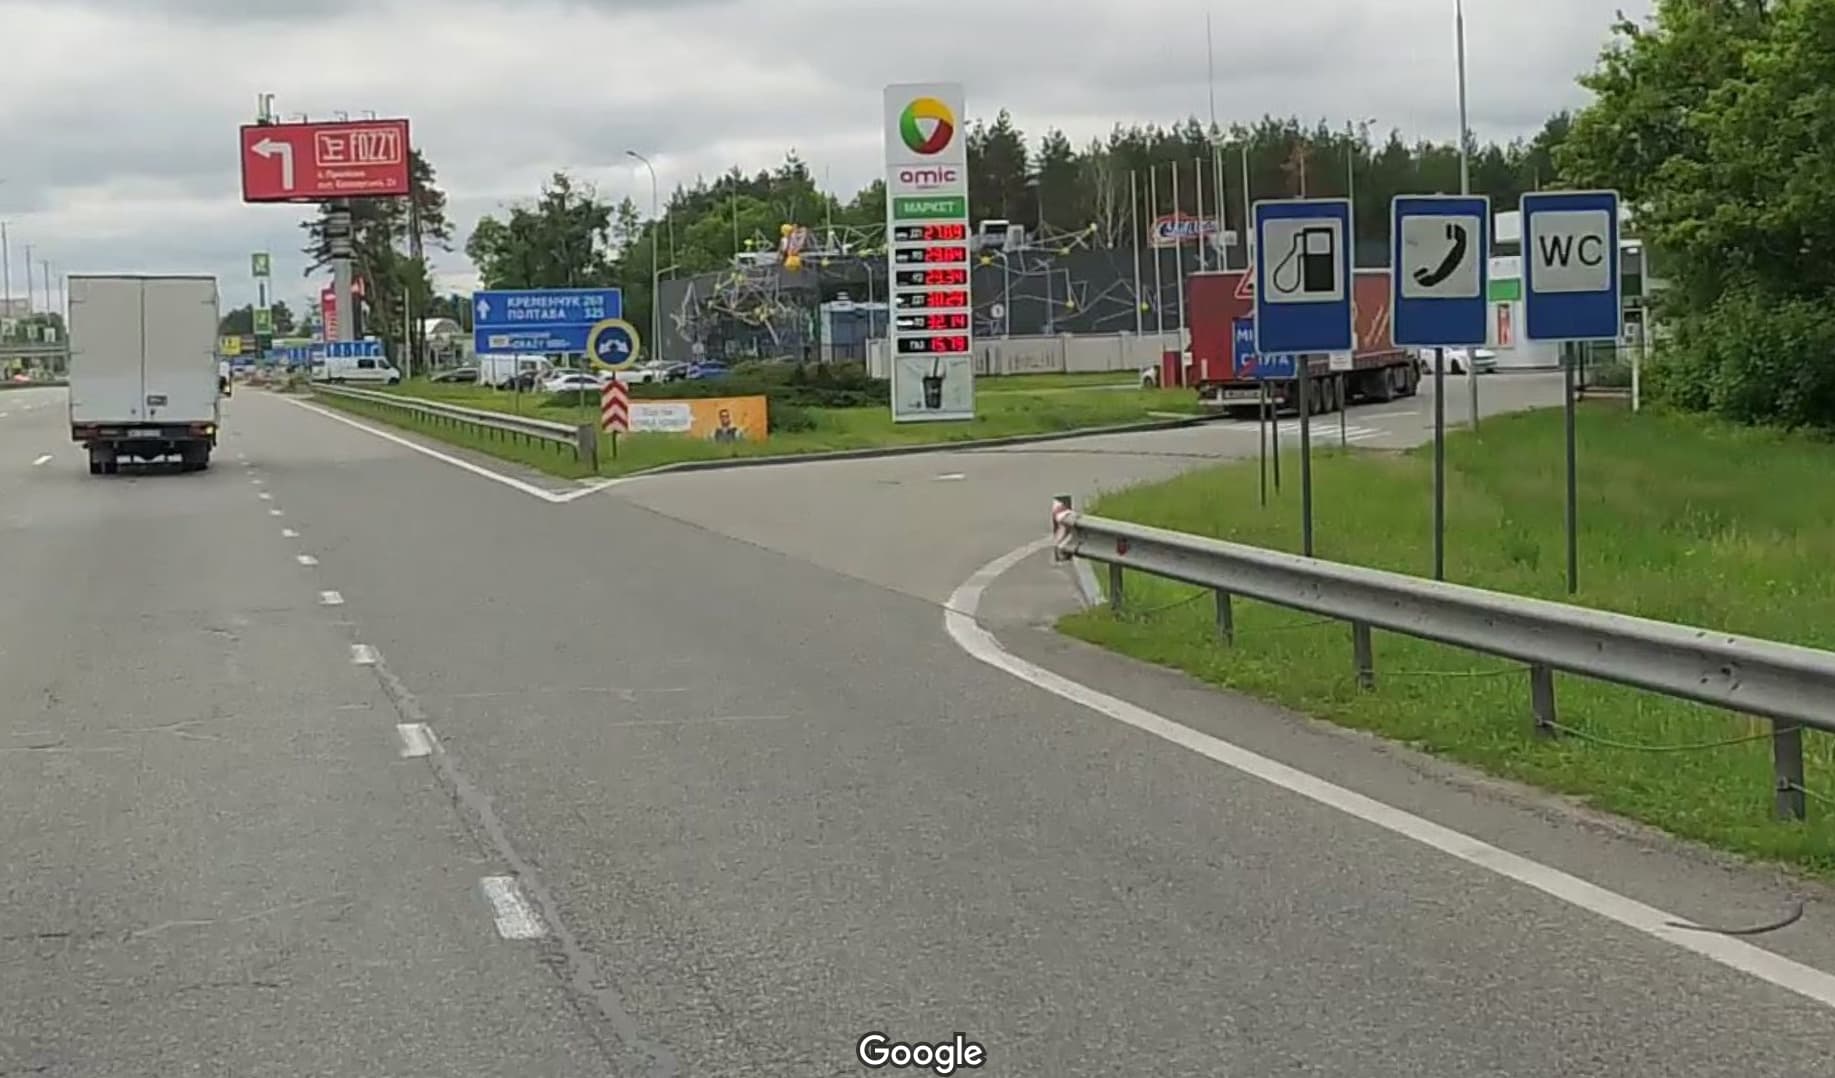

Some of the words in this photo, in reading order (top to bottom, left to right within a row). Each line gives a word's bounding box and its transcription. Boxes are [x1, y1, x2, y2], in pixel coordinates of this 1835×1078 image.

[351, 132, 396, 161] FOZZY
[904, 202, 955, 213] МАРКЕТ
[1539, 235, 1603, 267] WC
[507, 296, 580, 307] КРЕМЕНЧУК
[507, 309, 566, 320] ПОЛТАВА
